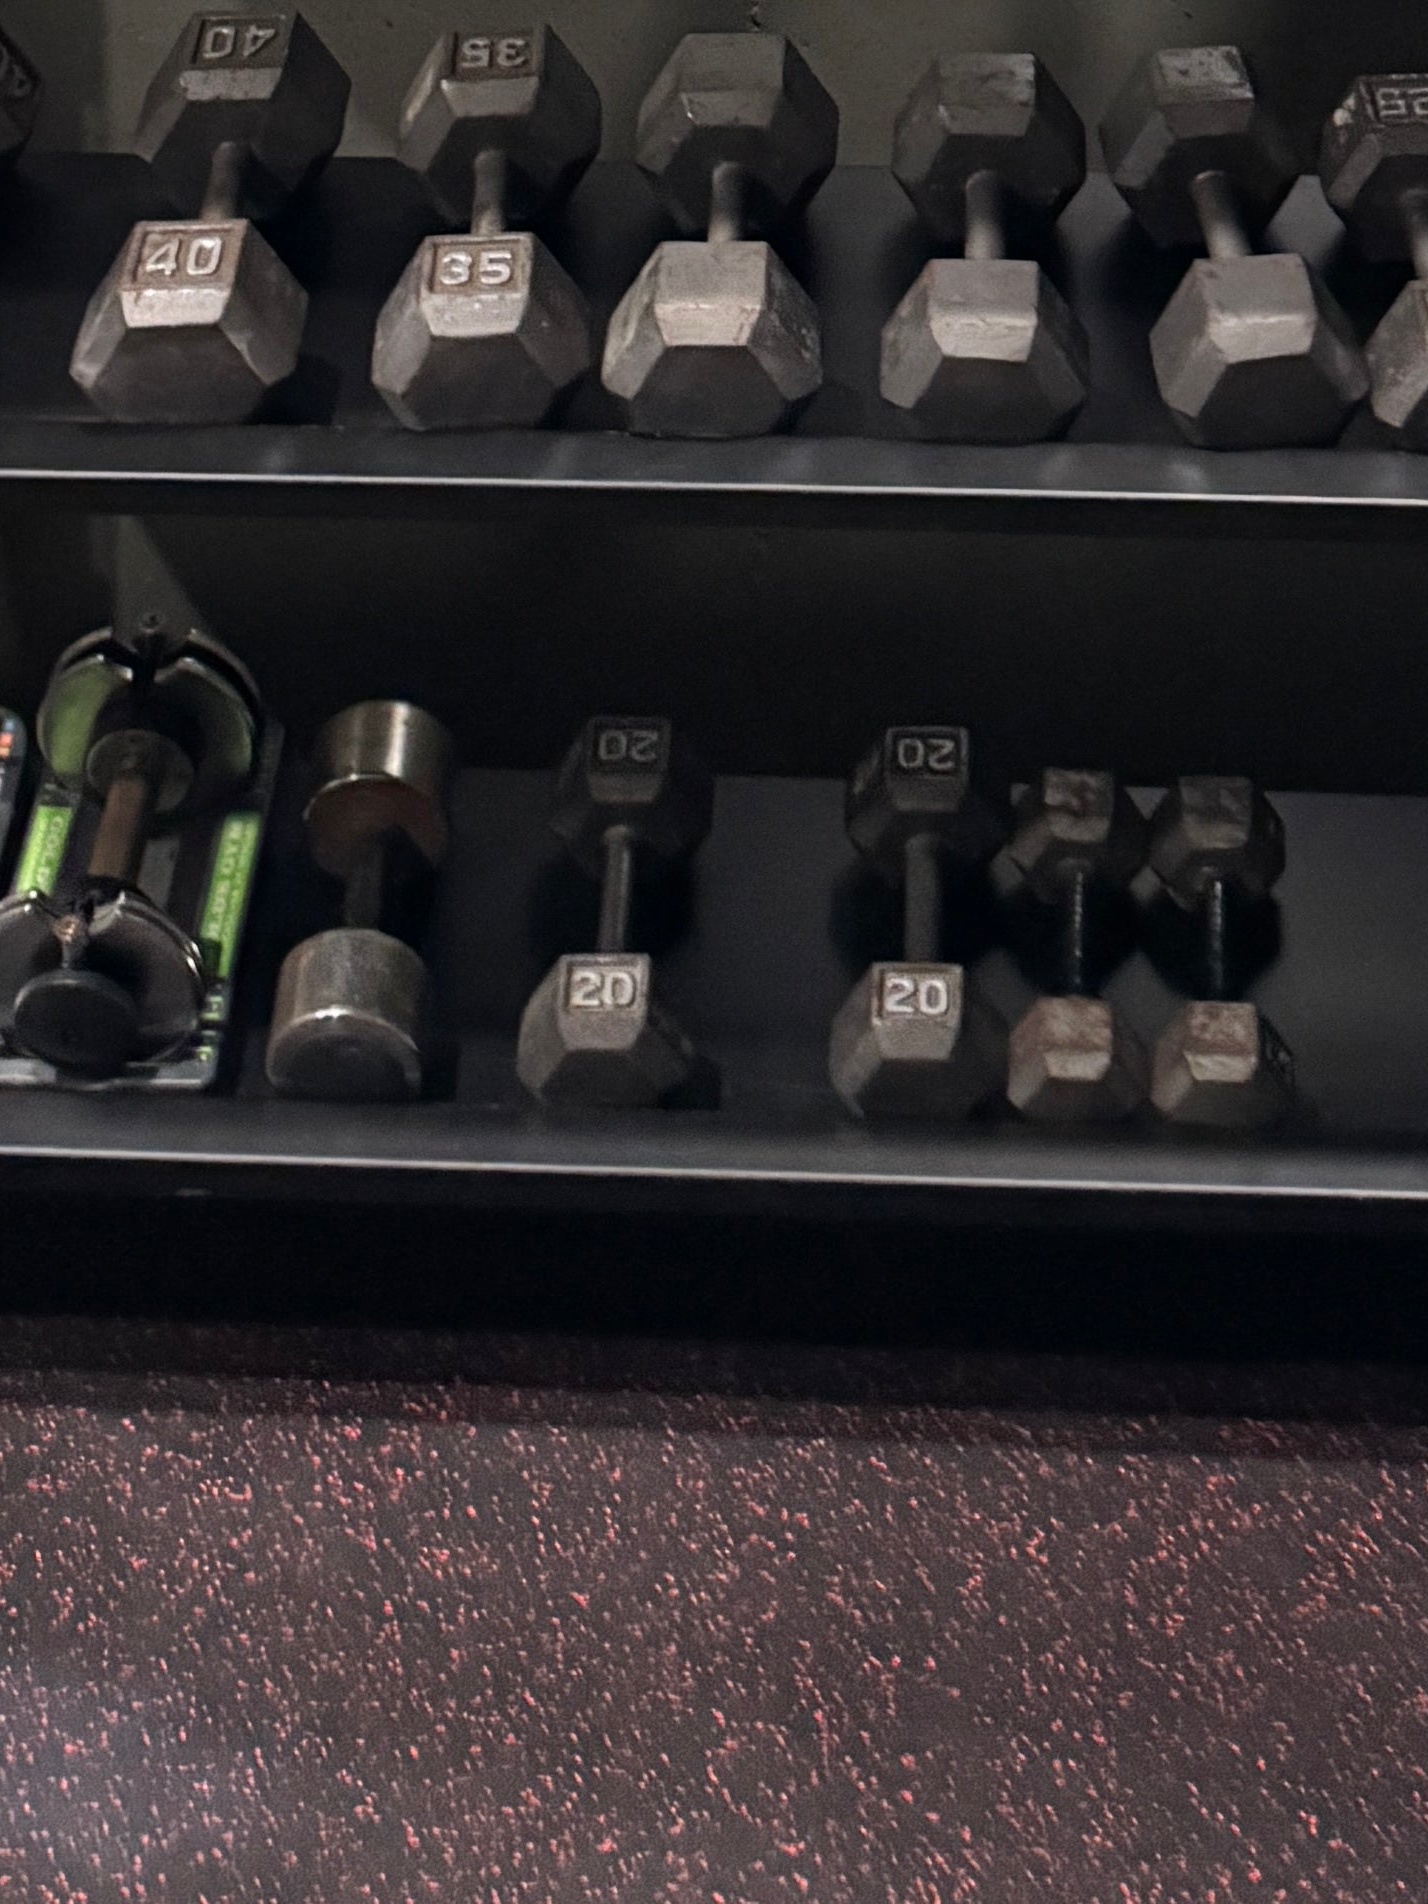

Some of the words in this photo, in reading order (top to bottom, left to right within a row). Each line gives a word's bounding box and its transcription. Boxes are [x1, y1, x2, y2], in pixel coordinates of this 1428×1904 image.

[203, 24, 275, 59] 40
[462, 36, 529, 68] 35
[144, 235, 222, 277] 40
[439, 250, 512, 286] 35
[599, 729, 659, 762] 20
[898, 737, 956, 772] 20
[572, 969, 634, 1007] 20
[884, 974, 949, 1015] 20
